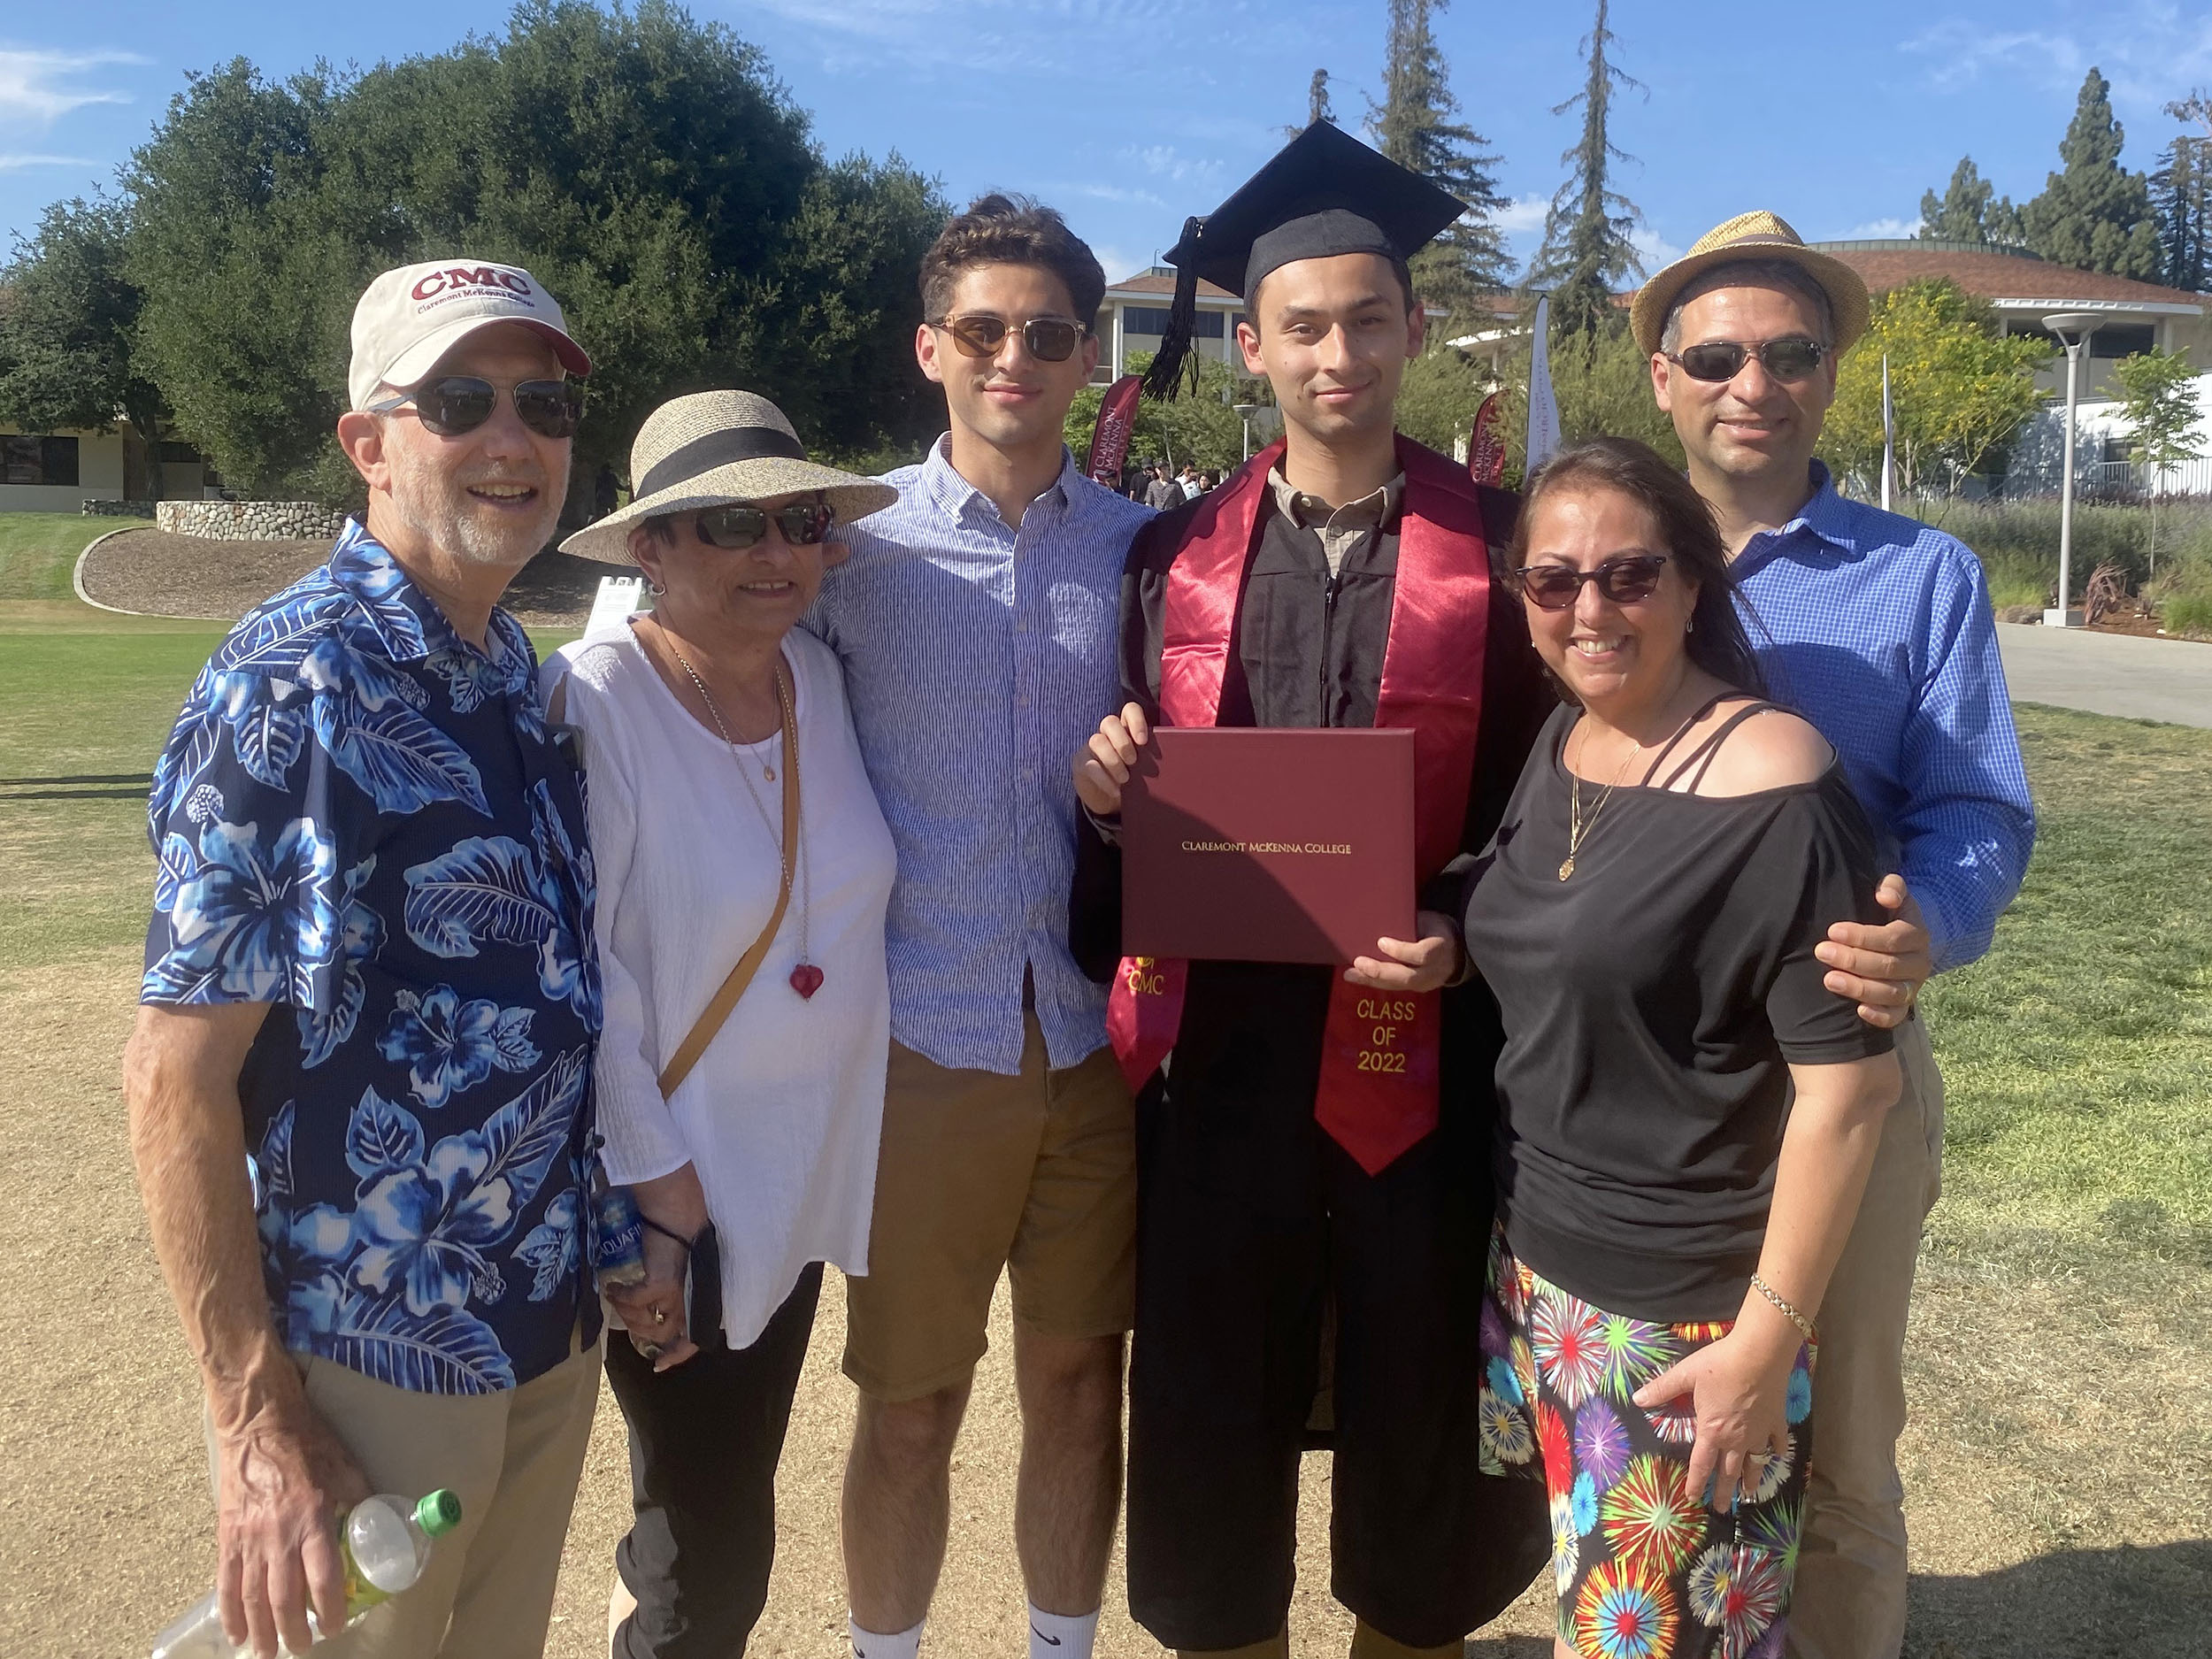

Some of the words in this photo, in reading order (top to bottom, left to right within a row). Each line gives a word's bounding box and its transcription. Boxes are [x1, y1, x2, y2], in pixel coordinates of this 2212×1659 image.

[411, 268, 531, 301] CMC
[418, 292, 462, 314] Claremont
[1094, 404, 1116, 468] CLAREMONT
[1181, 841, 1247, 852] CLAREMONT
[1304, 842, 1351, 855] COLLEGE
[1128, 970, 1164, 995] CMC
[1356, 999, 1417, 1021] CLASS
[1372, 1025, 1396, 1047] OF
[1356, 1050, 1406, 1073] 2022
